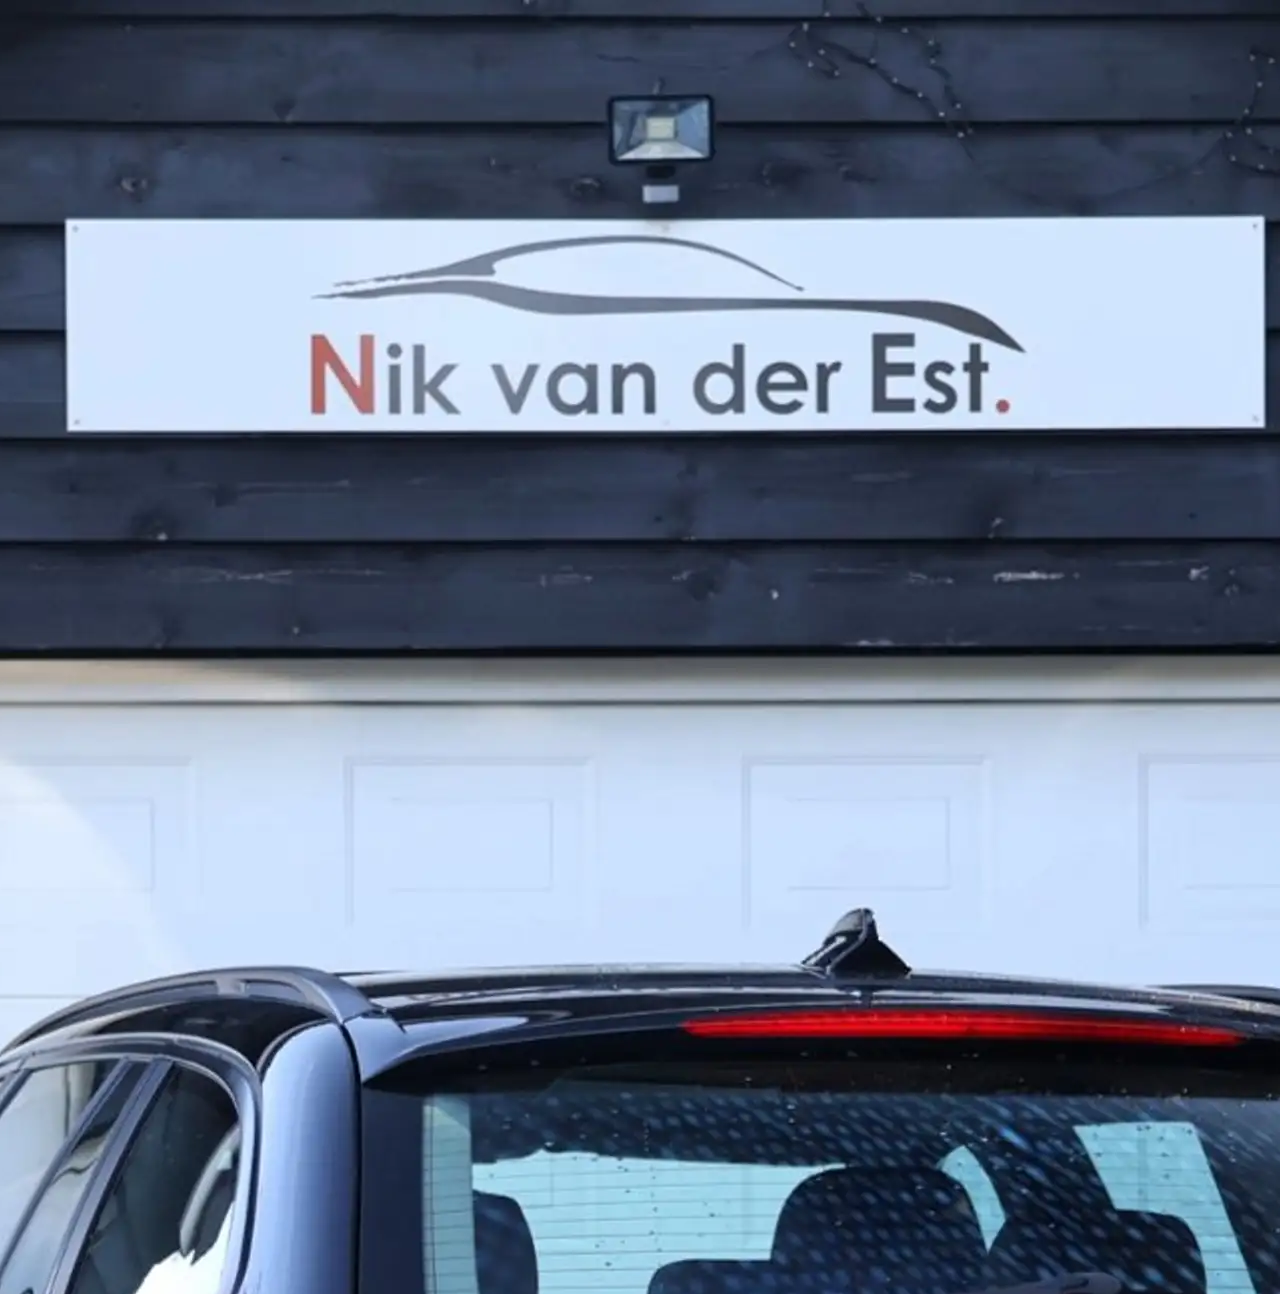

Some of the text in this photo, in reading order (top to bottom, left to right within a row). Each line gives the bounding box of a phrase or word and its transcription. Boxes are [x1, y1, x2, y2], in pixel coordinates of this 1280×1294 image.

[310, 332, 1012, 416] Nik van der Est.
